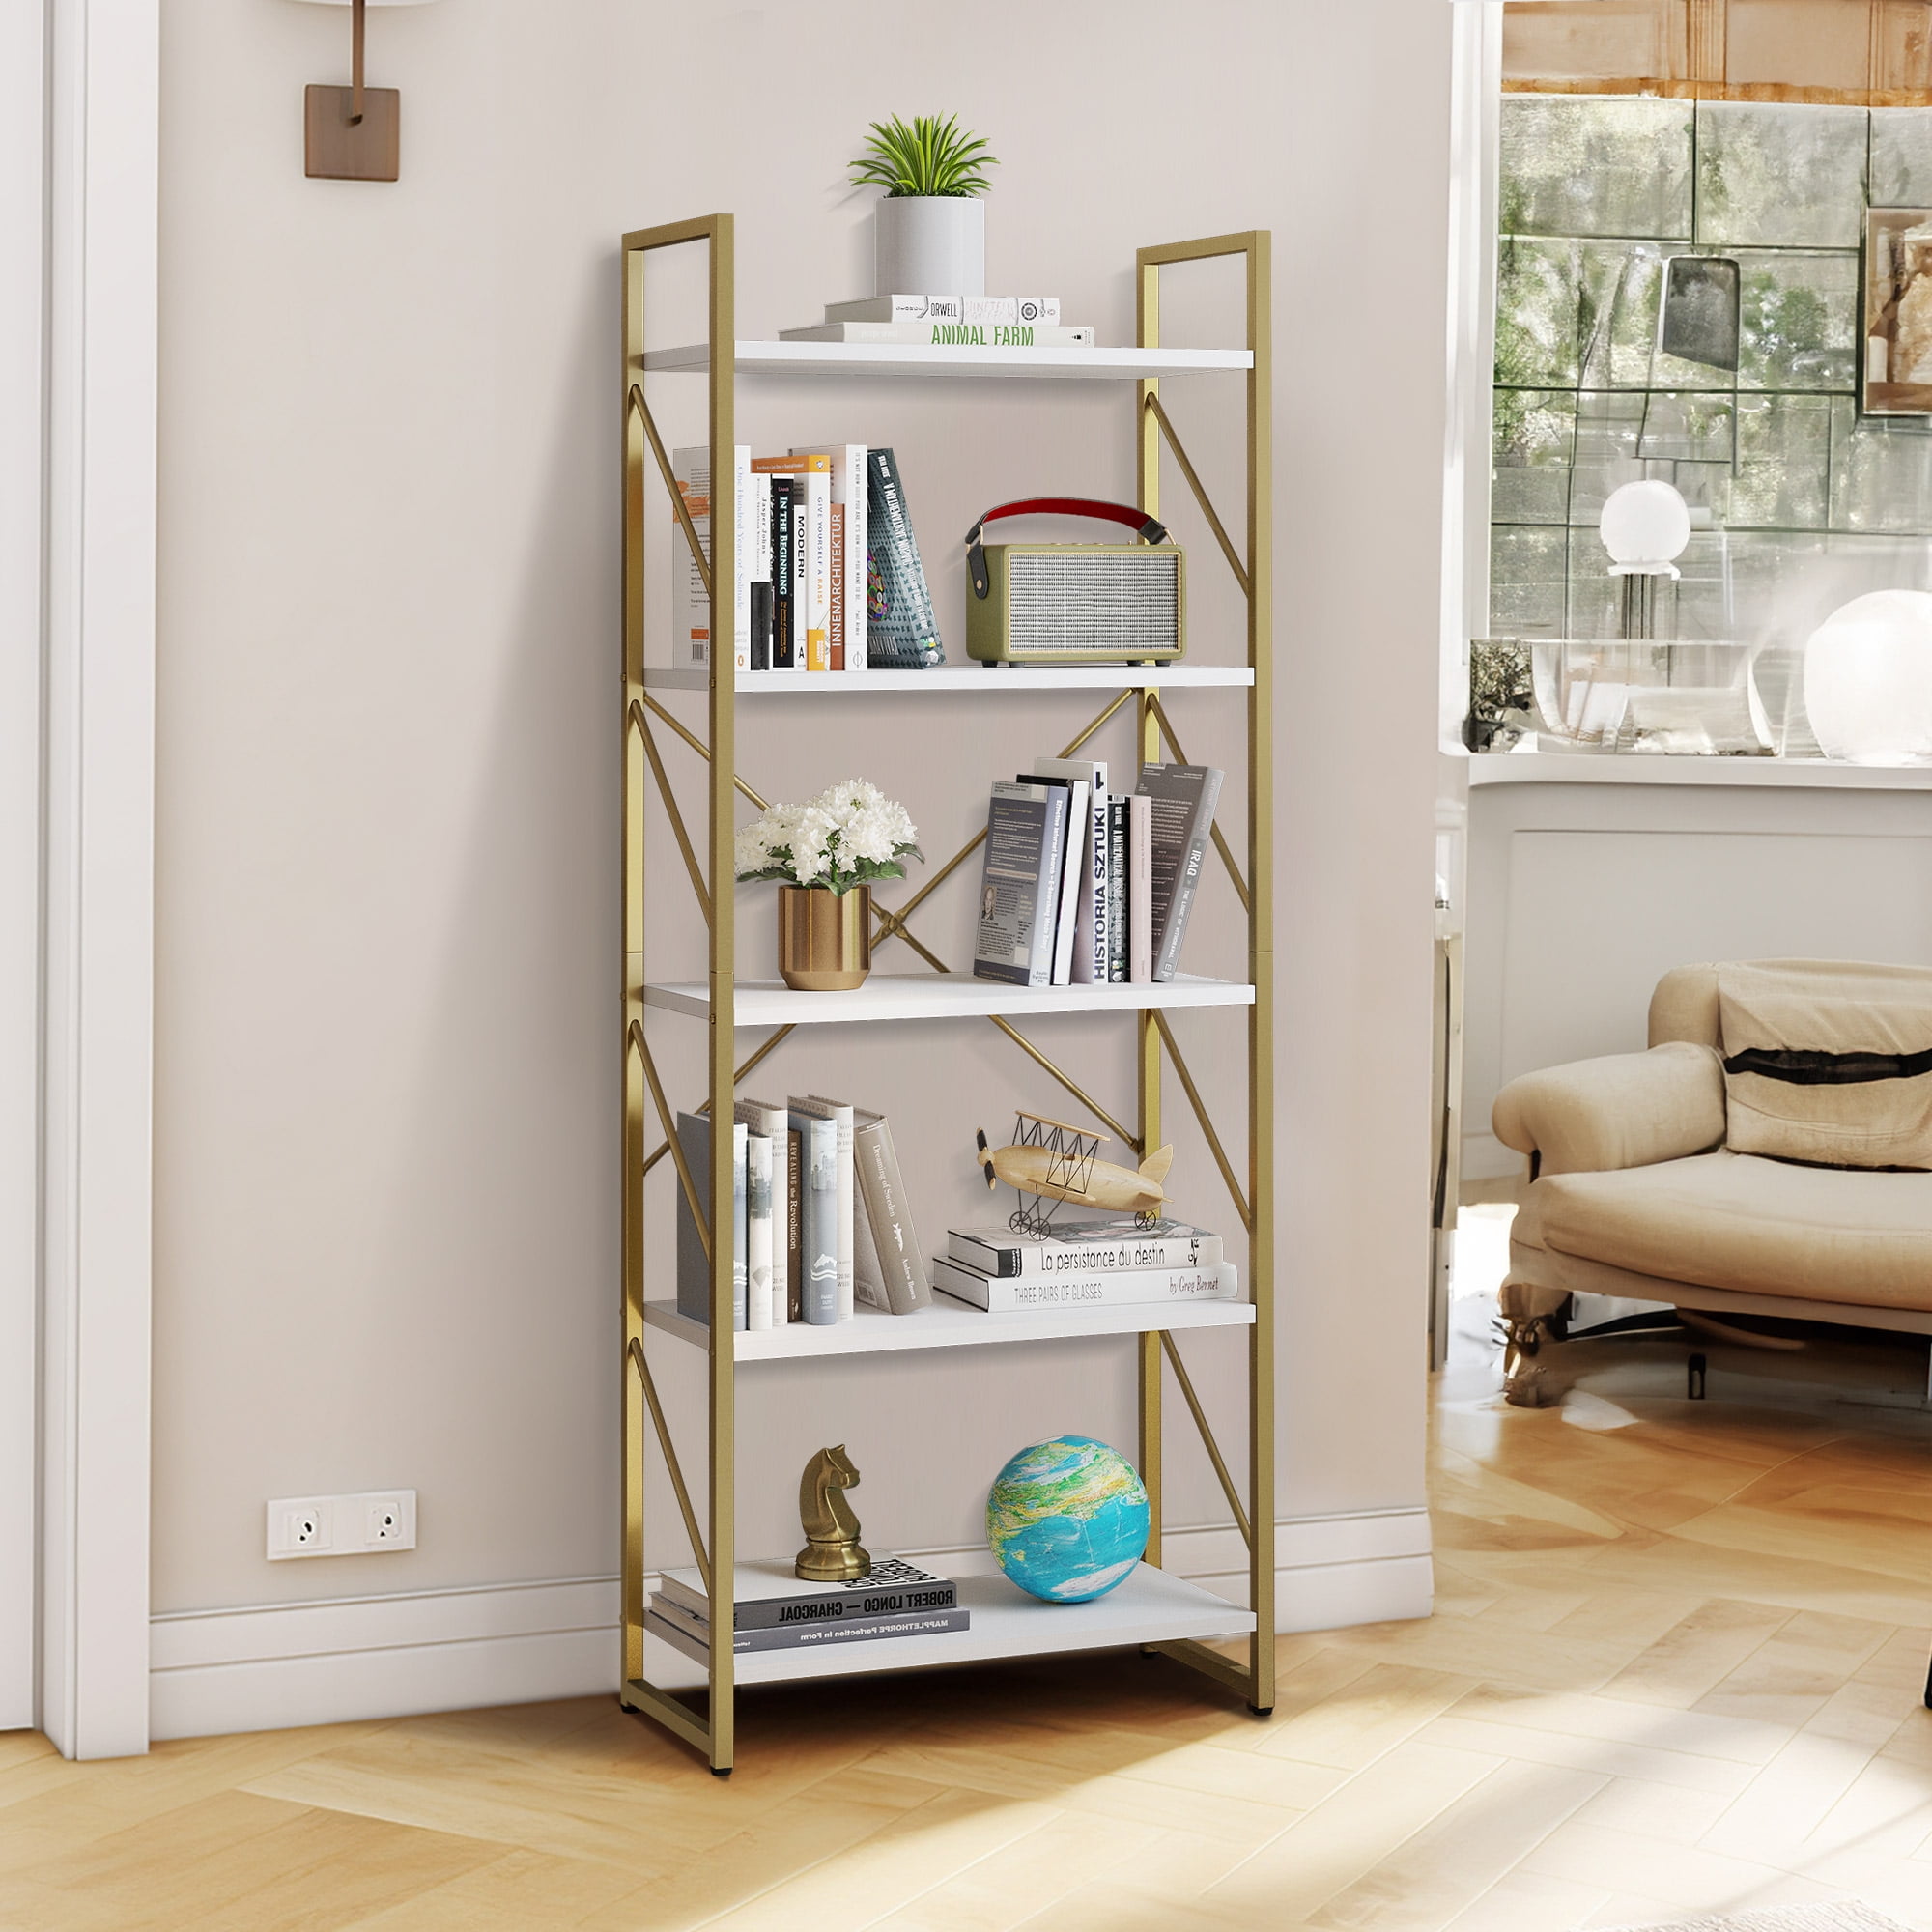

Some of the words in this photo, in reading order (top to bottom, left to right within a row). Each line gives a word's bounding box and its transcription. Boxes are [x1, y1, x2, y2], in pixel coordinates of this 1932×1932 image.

[930, 302, 957, 317] ORWELL
[931, 325, 987, 346] ANIMAL
[994, 326, 1034, 346] FARM
[780, 497, 788, 509] IN
[780, 511, 788, 532] THE
[736, 557, 744, 568] of
[780, 534, 788, 595] BEGINNING
[832, 513, 842, 646] INNENARCHITEKTUR
[798, 646, 805, 659] A
[1095, 771, 1104, 790] 1
[1053, 799, 1063, 826] Effective
[1051, 827, 1060, 852] Internet
[1094, 807, 1105, 879] SZTUKI
[1048, 852, 1057, 874] Search
[1112, 835, 1123, 876] MATHEMATICAL
[1185, 848, 1202, 877] IRAQ
[1178, 900, 1188, 918] LOGIC
[1094, 884, 1105, 979] HISTORIA
[1167, 926, 1181, 959] WITHDRAWAL
[872, 1144, 887, 1180] Dreaming
[880, 1180, 891, 1189] of
[883, 1188, 895, 1218] Sweden
[789, 1200, 798, 1250] Revolution
[1041, 1247, 1053, 1271] La
[1056, 1244, 1115, 1275] persistance
[1119, 1244, 1132, 1266] du
[1135, 1242, 1165, 1265] destin
[901, 1258, 912, 1280] Andrew
[908, 1281, 917, 1300] Brown
[1168, 1279, 1178, 1294] by
[1179, 1276, 1195, 1293] Greg
[1197, 1275, 1219, 1292] Bennet
[1014, 1286, 1037, 1304] THREE
[1038, 1285, 1059, 1303] PAIRS
[1061, 1284, 1071, 1301] OF
[1072, 1282, 1103, 1300] GLASSES
